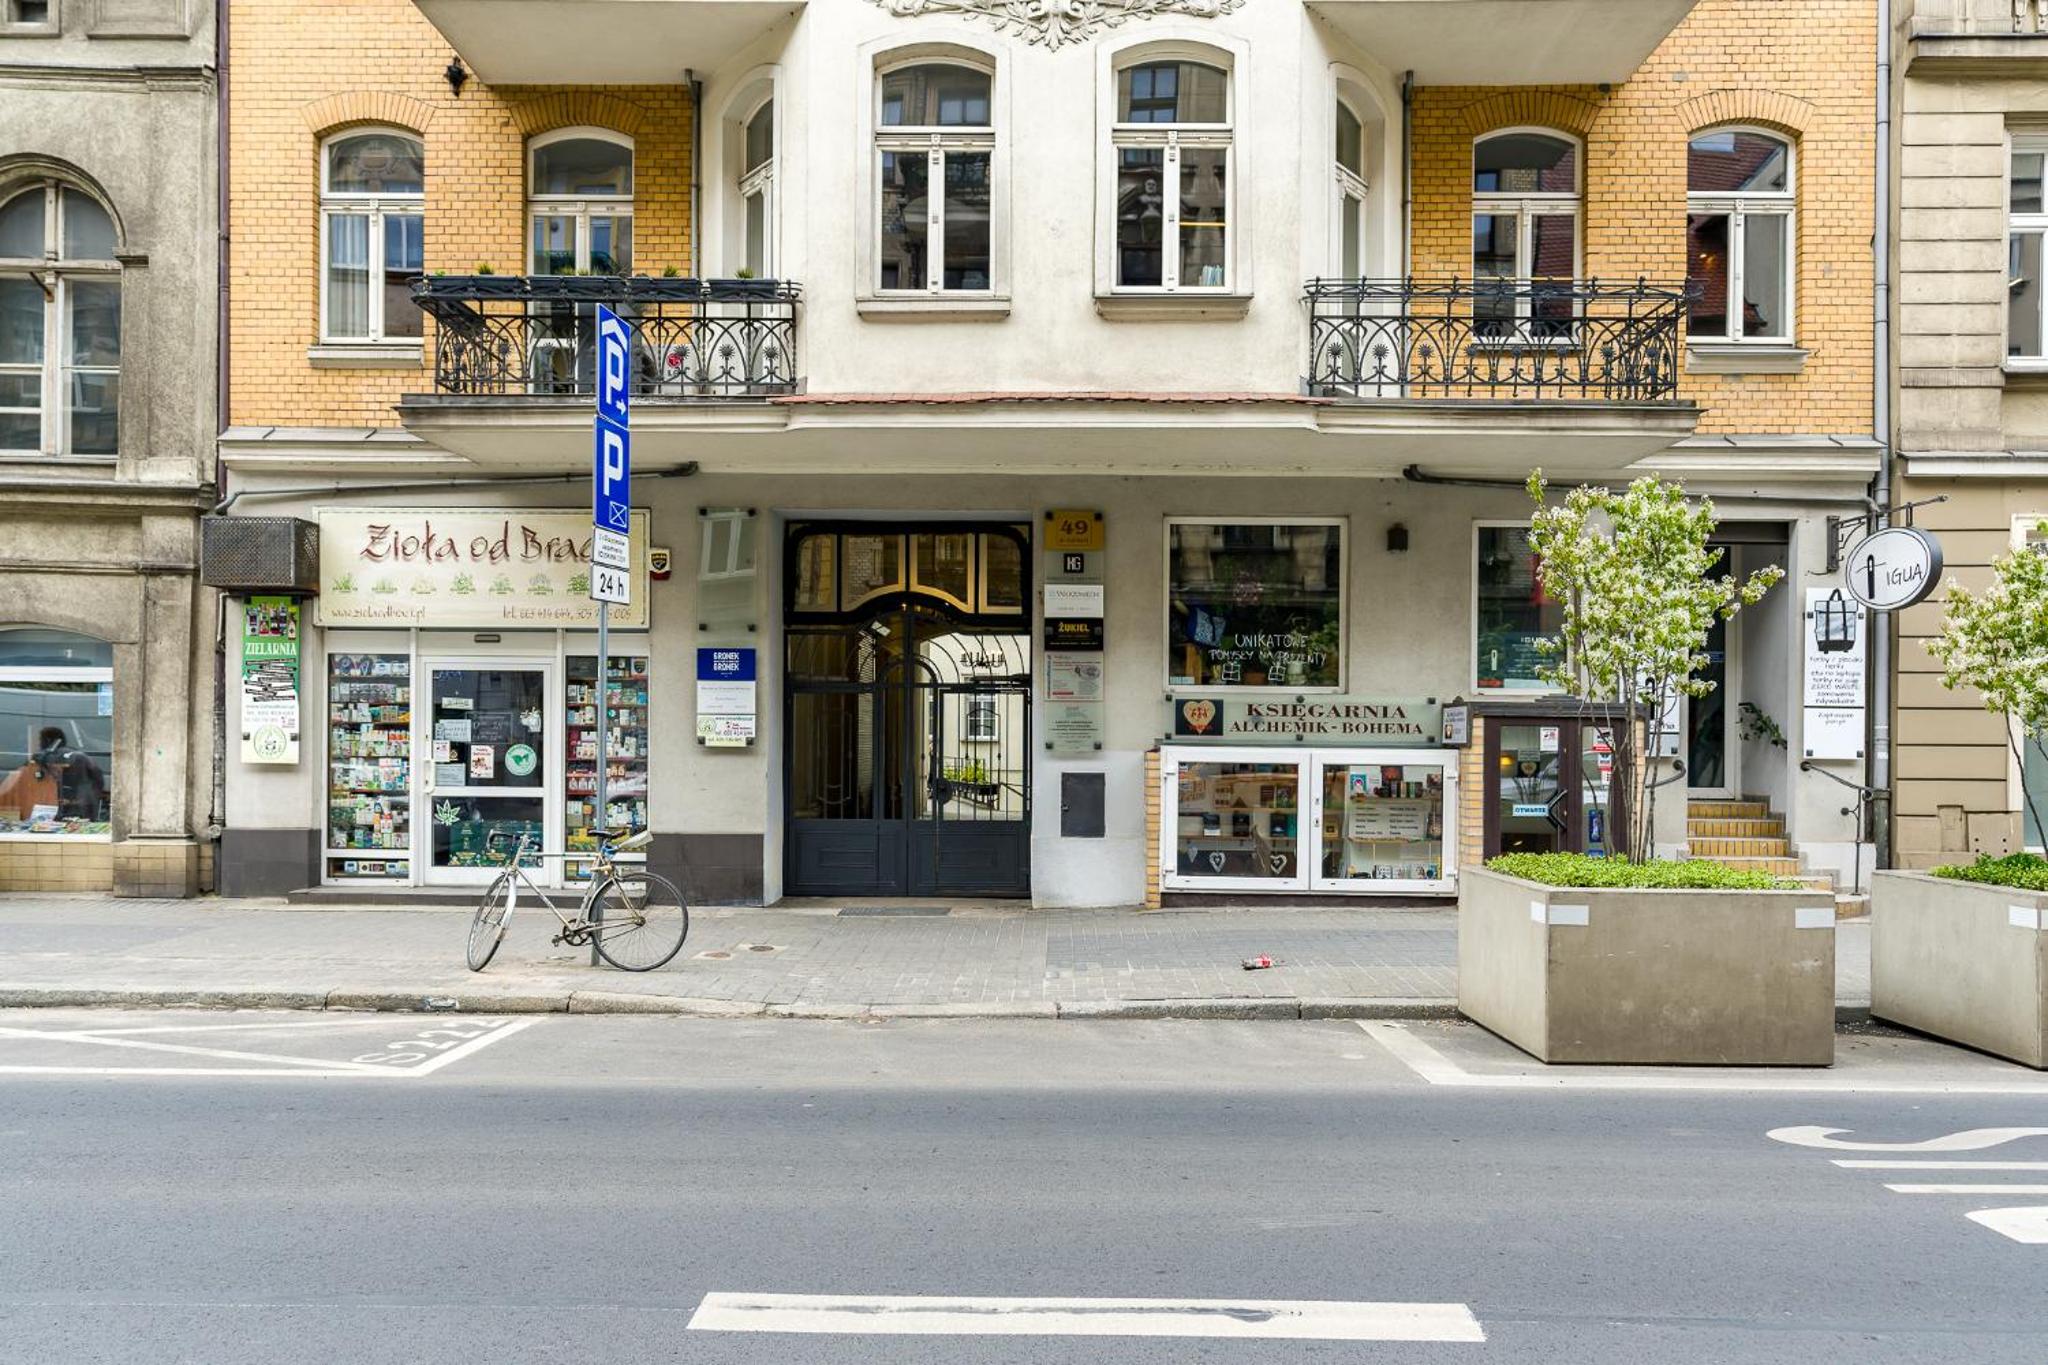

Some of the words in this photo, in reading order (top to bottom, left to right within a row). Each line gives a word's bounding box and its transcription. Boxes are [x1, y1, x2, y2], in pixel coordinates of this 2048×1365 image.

[605, 337, 625, 405] P
[603, 429, 624, 497] P
[1060, 519, 1089, 535] 49
[360, 520, 459, 564] Zioła
[471, 520, 510, 562] od
[600, 573, 613, 595] 24
[617, 577, 625, 597] h
[1886, 563, 1923, 586] IGUA
[245, 643, 297, 656] ZIELARNIA
[1247, 703, 1406, 720] KSIĘGARNIA
